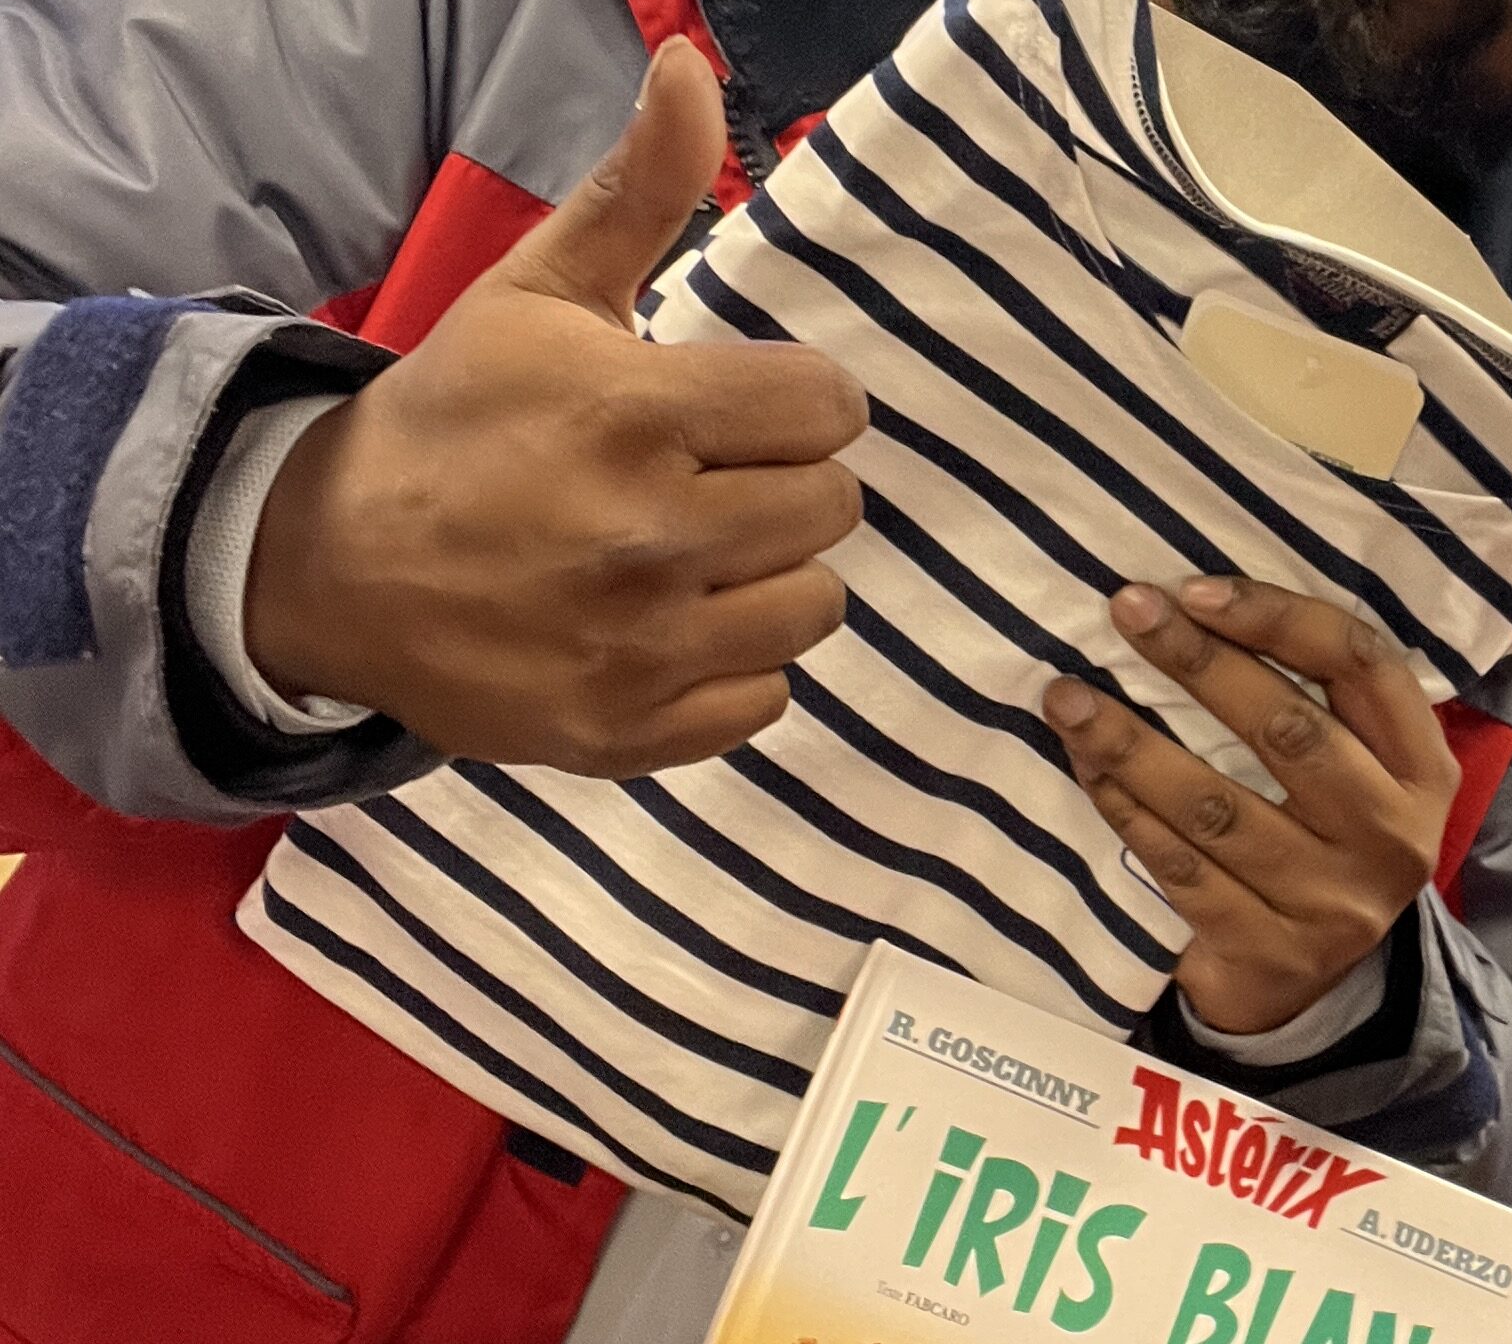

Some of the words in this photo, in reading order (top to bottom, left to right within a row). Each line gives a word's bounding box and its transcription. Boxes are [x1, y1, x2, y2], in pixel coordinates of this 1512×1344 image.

[887, 1010, 919, 1044] R.
[928, 1027, 1101, 1115] GOSCINNY
[1113, 1065, 1388, 1229] Astérix
[1357, 1208, 1387, 1243] A.
[1395, 1220, 1512, 1290] UDERZO
[904, 1290, 970, 1327] FABCARO
